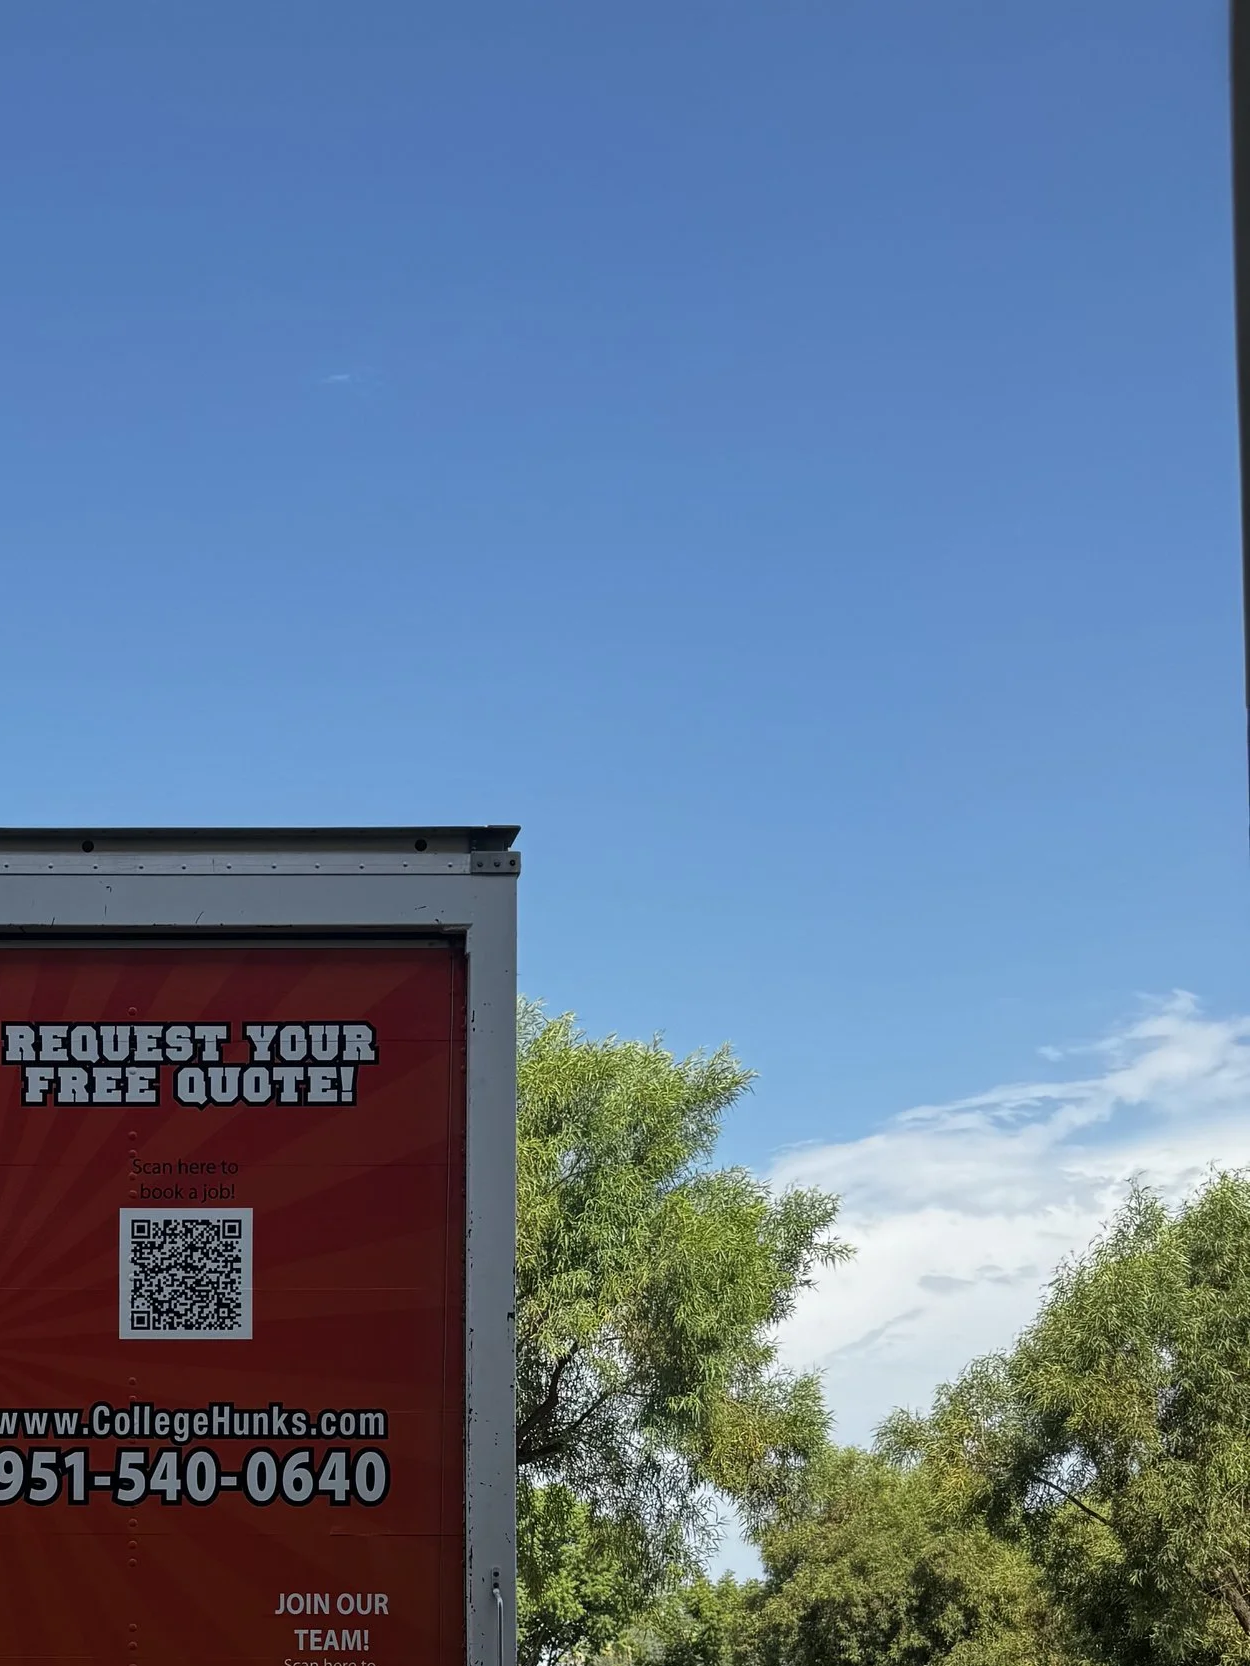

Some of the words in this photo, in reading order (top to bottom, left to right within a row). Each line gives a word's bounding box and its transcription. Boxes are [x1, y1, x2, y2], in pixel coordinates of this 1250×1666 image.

[4, 1024, 229, 1064] REQUEST
[246, 1024, 376, 1062] YOUR
[24, 1066, 157, 1103] FREE
[176, 1066, 355, 1106] QUOTE!
[132, 1158, 173, 1175] Scan
[178, 1158, 216, 1175] here
[221, 1160, 239, 1175] to
[140, 1183, 184, 1199] book
[188, 1187, 198, 1199] a
[201, 1183, 235, 1203] job!
[274, 1593, 330, 1615] JOIN
[336, 1593, 389, 1615] OUR
[294, 1629, 369, 1651] TEAM!
